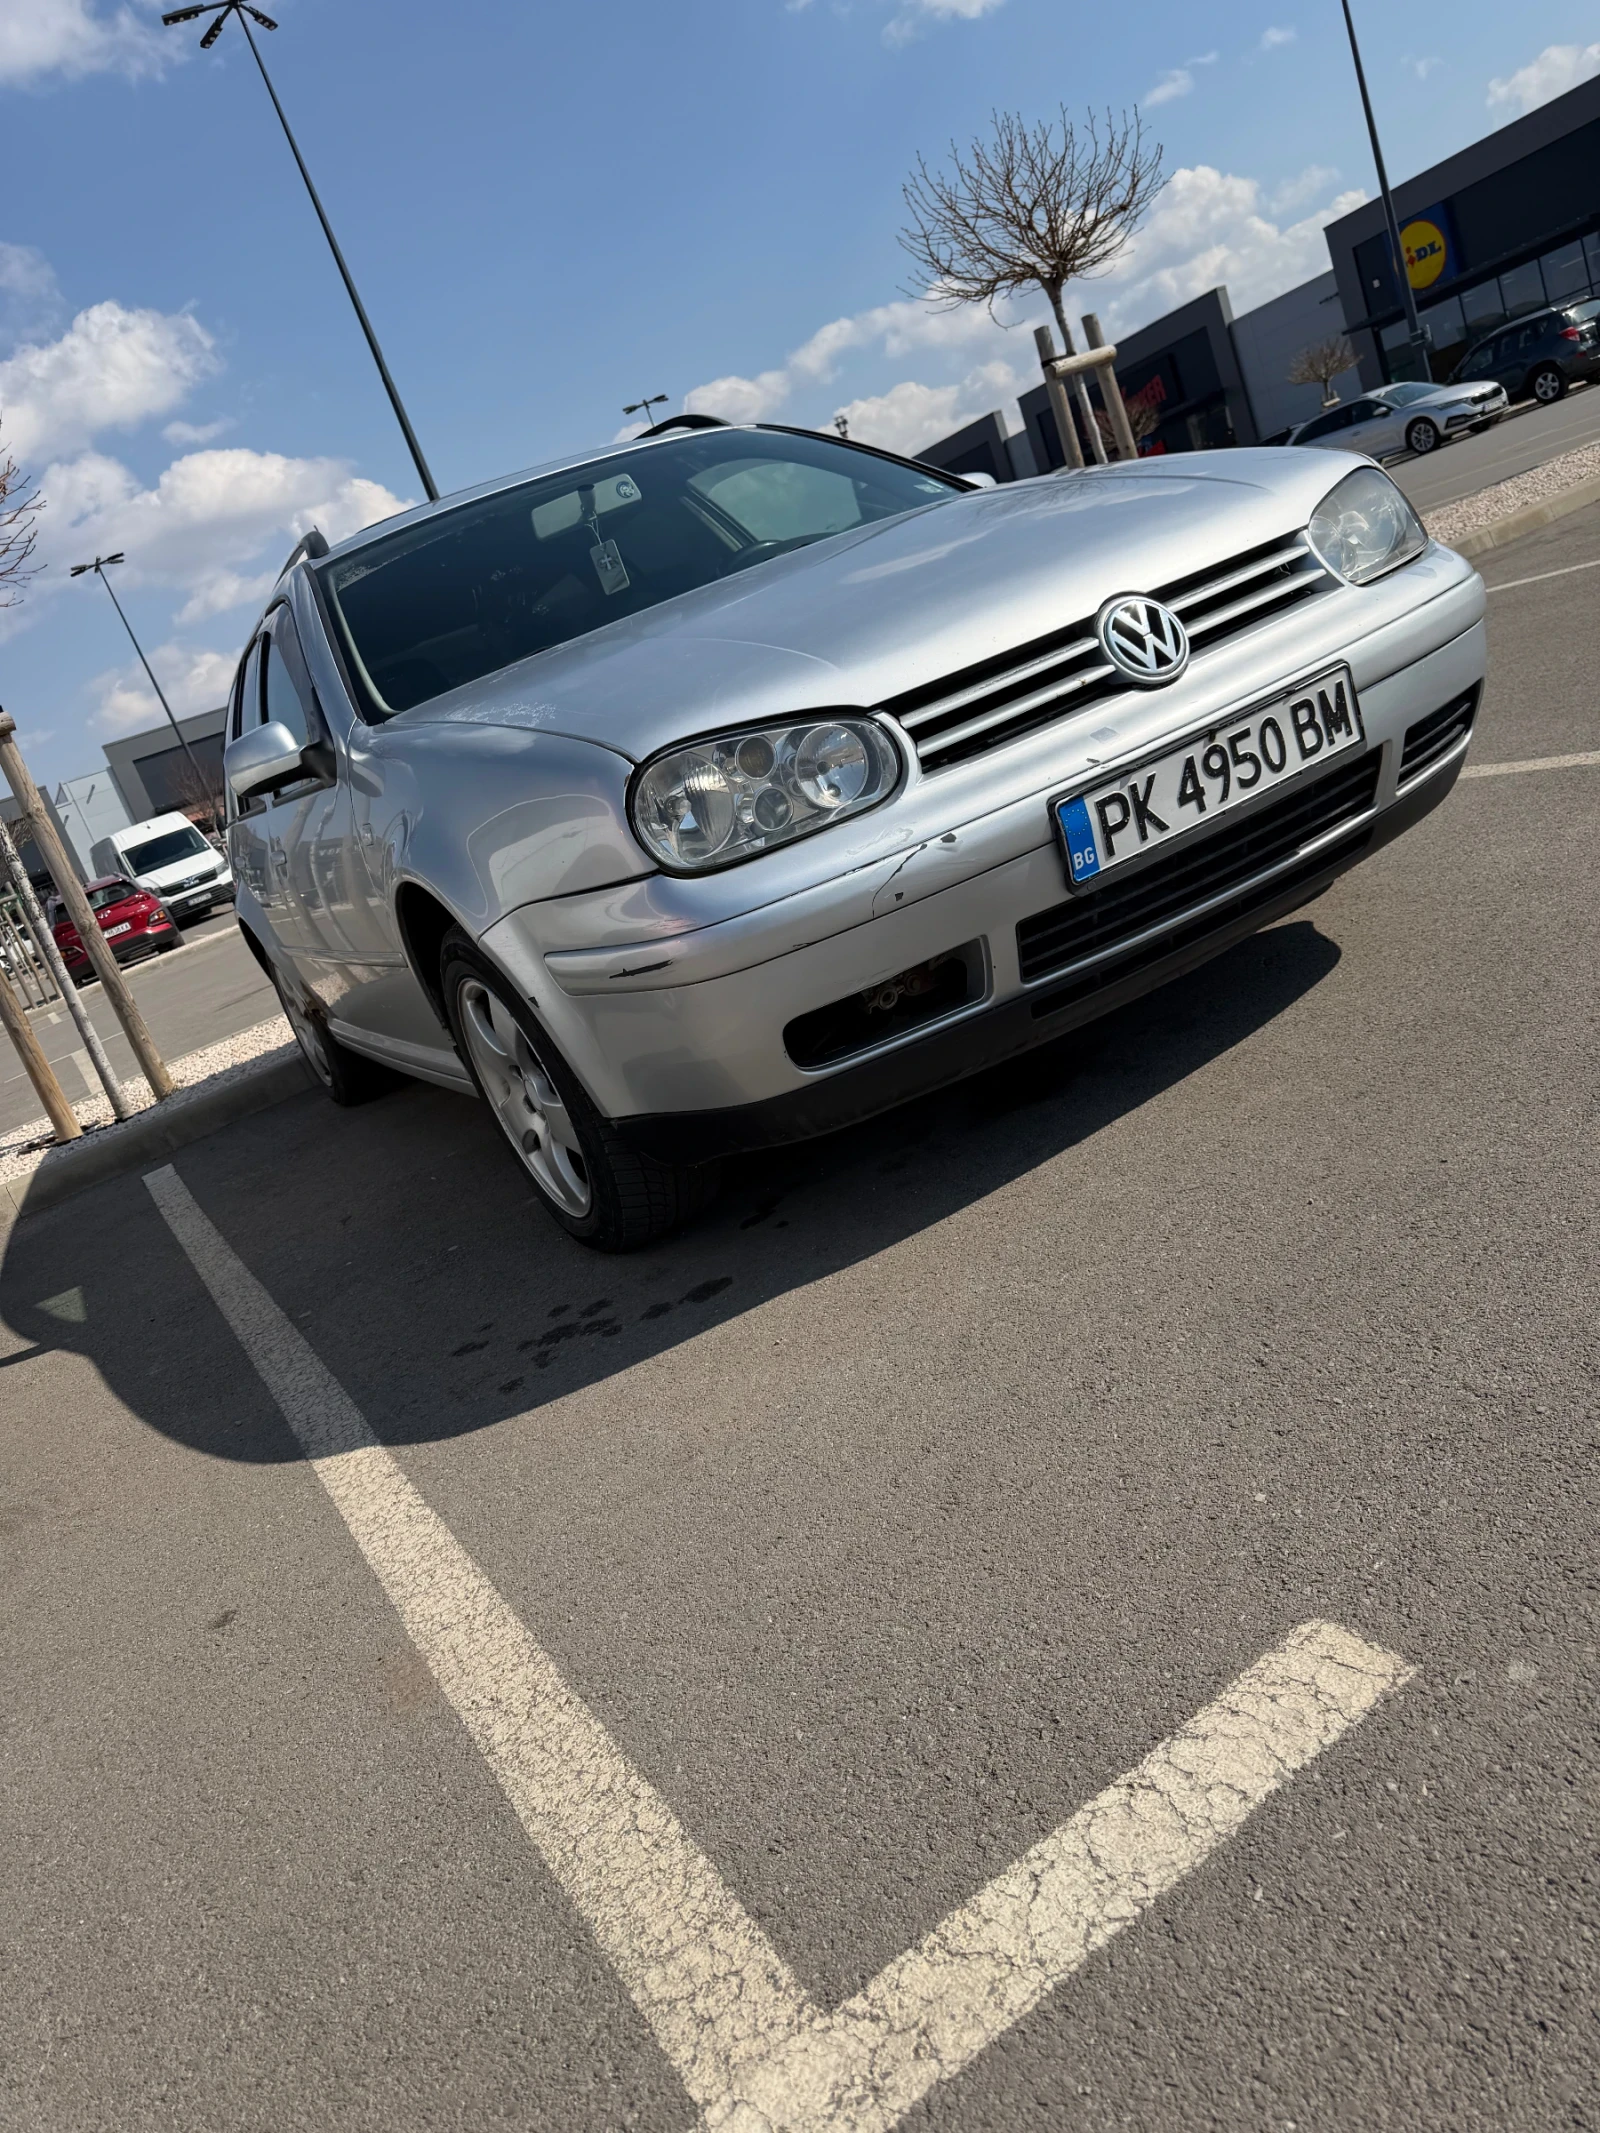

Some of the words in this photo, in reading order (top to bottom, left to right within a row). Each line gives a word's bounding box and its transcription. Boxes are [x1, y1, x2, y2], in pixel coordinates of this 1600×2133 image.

[1107, 598, 1183, 673] VW
[1096, 771, 1170, 859] PK
[1177, 716, 1286, 814] 4950
[1290, 679, 1353, 761] BM
[1073, 846, 1095, 870] BG
